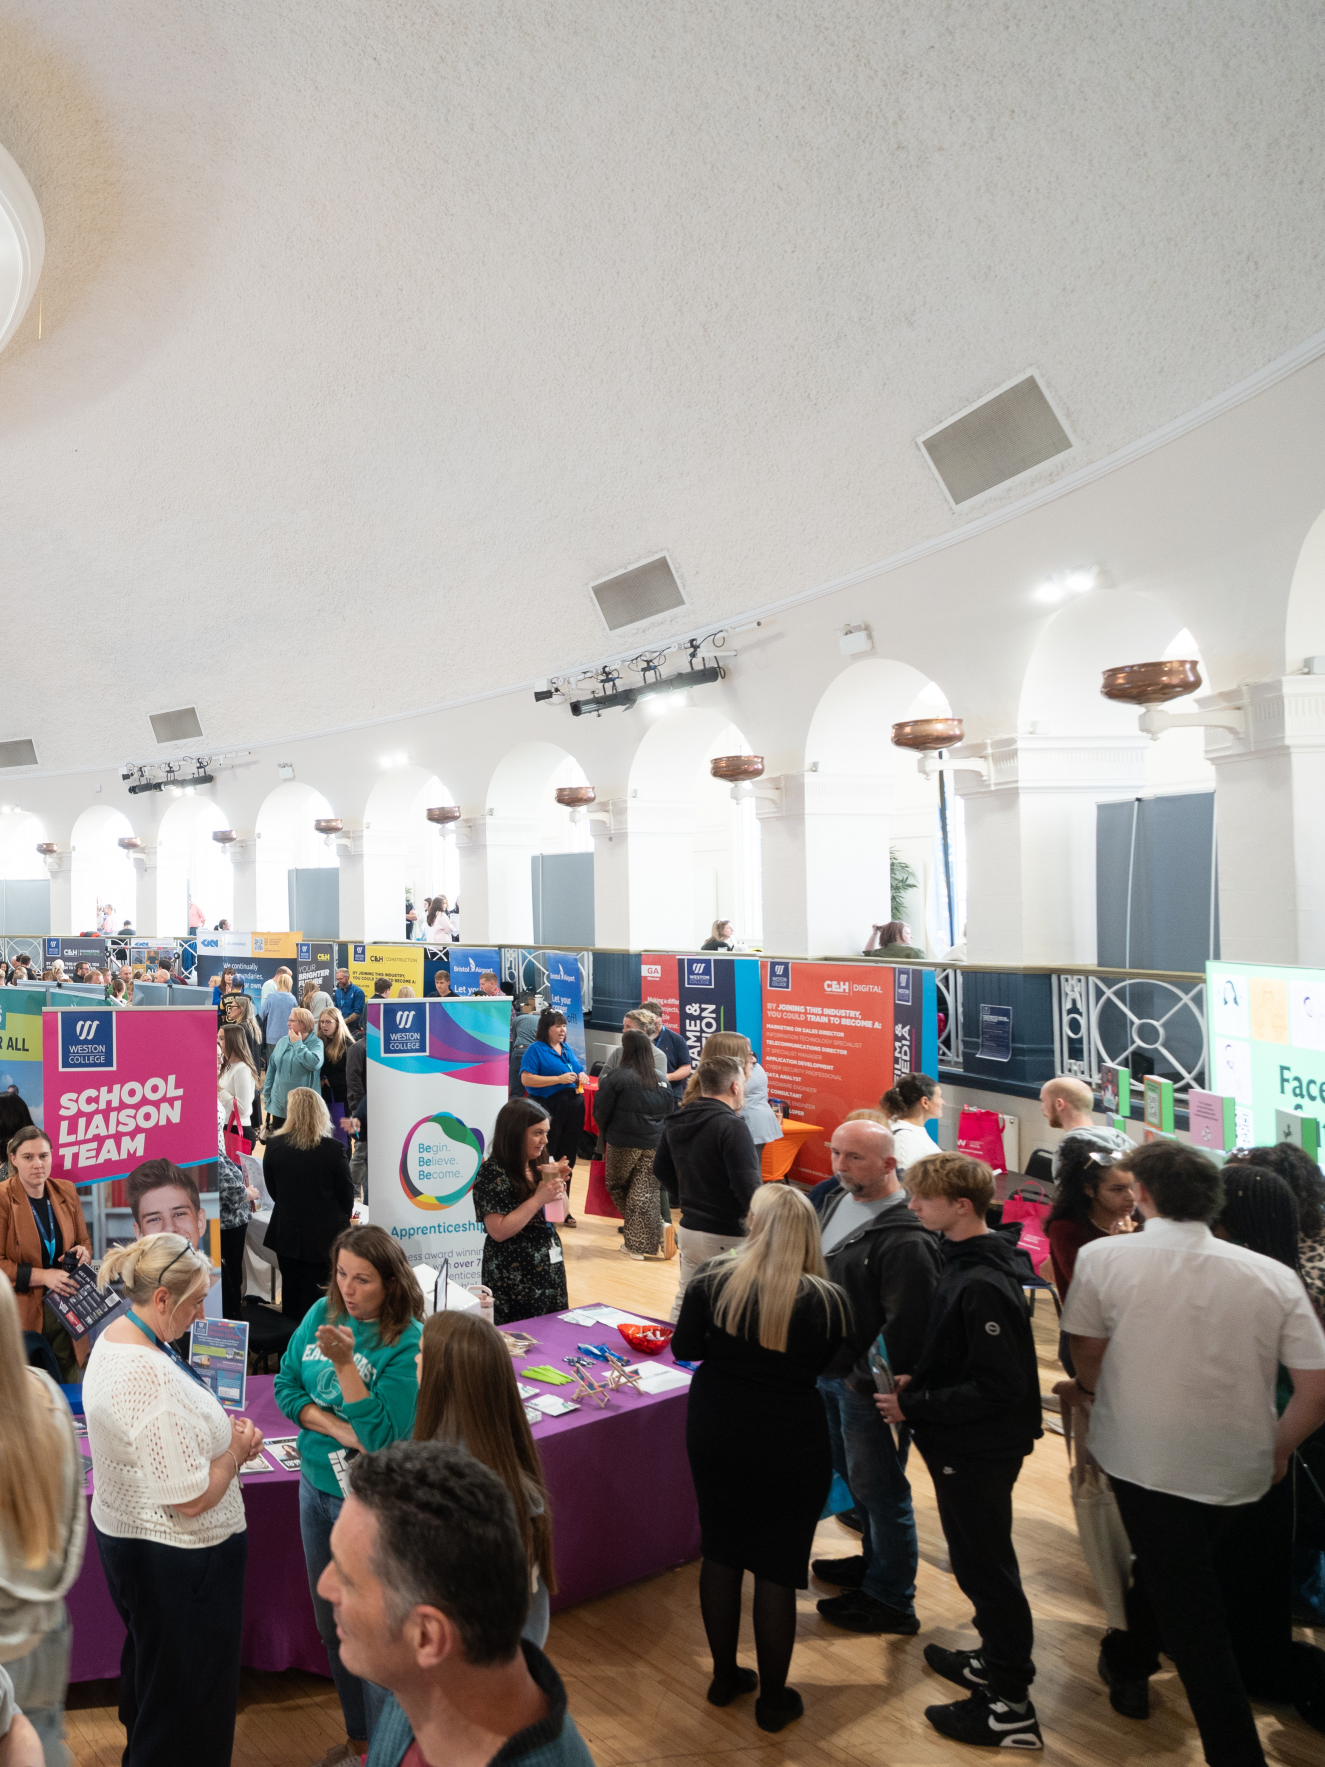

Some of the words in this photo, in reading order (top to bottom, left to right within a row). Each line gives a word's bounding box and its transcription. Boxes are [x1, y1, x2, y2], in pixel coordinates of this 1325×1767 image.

[201, 939, 218, 947] GKN
[232, 962, 258, 971] continually
[299, 964, 316, 973] YOUR
[475, 966, 493, 974] Airport
[647, 967, 659, 975] GA
[299, 969, 330, 980] BRIGHTER
[455, 985, 466, 993] Let
[853, 984, 883, 993] DIGITAL
[552, 994, 560, 1003] Let
[560, 997, 571, 1005] your
[685, 1003, 700, 1015] &
[777, 1004, 805, 1012] JOINING
[806, 1006, 822, 1014] THIS
[823, 1008, 861, 1019] INDUSTRY,
[783, 1012, 805, 1020] COULD
[806, 1014, 828, 1023] TRAIN
[841, 1018, 872, 1028] BECOME
[873, 1021, 882, 1029] A:
[766, 1024, 794, 1032] MARKETING
[819, 1029, 844, 1037] DIRECTOR
[895, 1023, 903, 1037] &
[390, 1033, 420, 1041] WESTON
[766, 1032, 798, 1040] INFORMATION
[799, 1035, 833, 1045] TECHNOLOGY
[834, 1040, 862, 1048] SPECIALIST
[6, 1037, 29, 1052] ALL
[69, 1045, 105, 1053] WESTON
[686, 1019, 701, 1074] GAME
[766, 1039, 821, 1052] TELECOMMUNICATIONS
[822, 1047, 848, 1055] DIRECTOR
[771, 1048, 797, 1057] SPECIALIST
[798, 1052, 822, 1060] MANAGER
[766, 1055, 797, 1065] APPLICATION
[798, 1060, 834, 1070] DEVELOPMENT
[766, 1063, 782, 1071] CYBER
[783, 1065, 805, 1074] SECURITY
[805, 1069, 843, 1081] PROFESSIONAL
[780, 1074, 802, 1082] ANALYST
[768, 1080, 793, 1089] ARDWARE
[793, 1084, 817, 1093] ENGINEER
[59, 1074, 184, 1116] SCHOOL
[771, 1088, 802, 1099] CONSULTANT
[792, 1101, 815, 1110] ENGINEER
[59, 1100, 182, 1144] LIAISON
[59, 1133, 146, 1170] TEAM
[418, 1143, 450, 1155] Begin.
[418, 1156, 458, 1167] Believe.
[418, 1169, 463, 1180] Become.
[424, 1249, 453, 1260] award
[455, 1248, 484, 1257] winnin
[453, 1261, 473, 1269] over
[78, 1270, 86, 1279] GET
